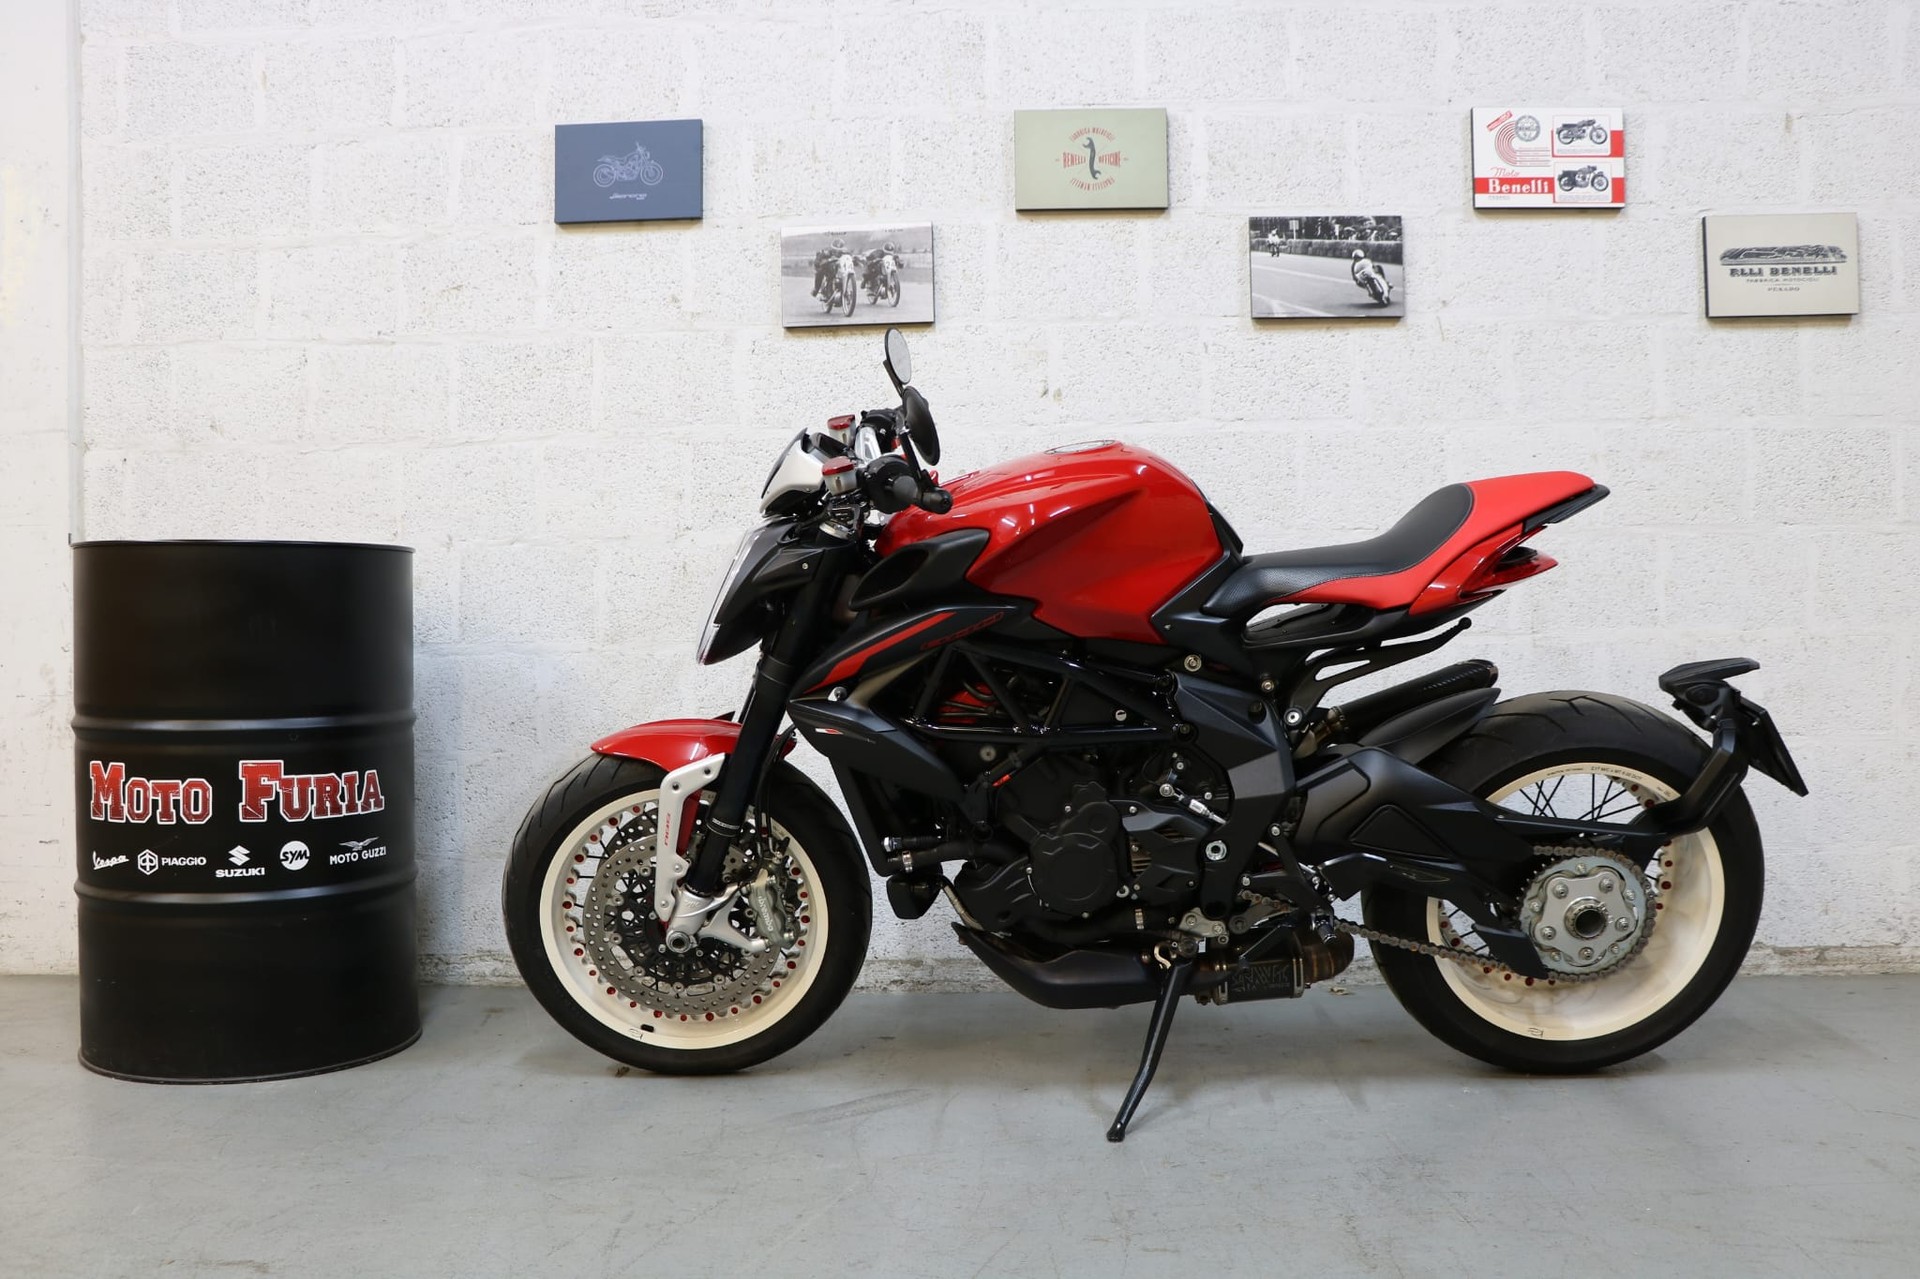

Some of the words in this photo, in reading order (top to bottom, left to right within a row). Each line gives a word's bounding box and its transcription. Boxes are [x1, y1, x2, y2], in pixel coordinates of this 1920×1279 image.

[1062, 151, 1086, 168] BENELLI
[1488, 178, 1549, 194] Benelli
[1769, 266, 1837, 277] BENELLI
[92, 850, 130, 870] Vespa
[161, 856, 207, 866] PIAGGIO
[280, 849, 310, 864] SYM
[329, 852, 359, 866] MOTO
[361, 845, 387, 860] GUZZI
[215, 867, 266, 878] SUZUKI
[758, 897, 774, 932] brembo
